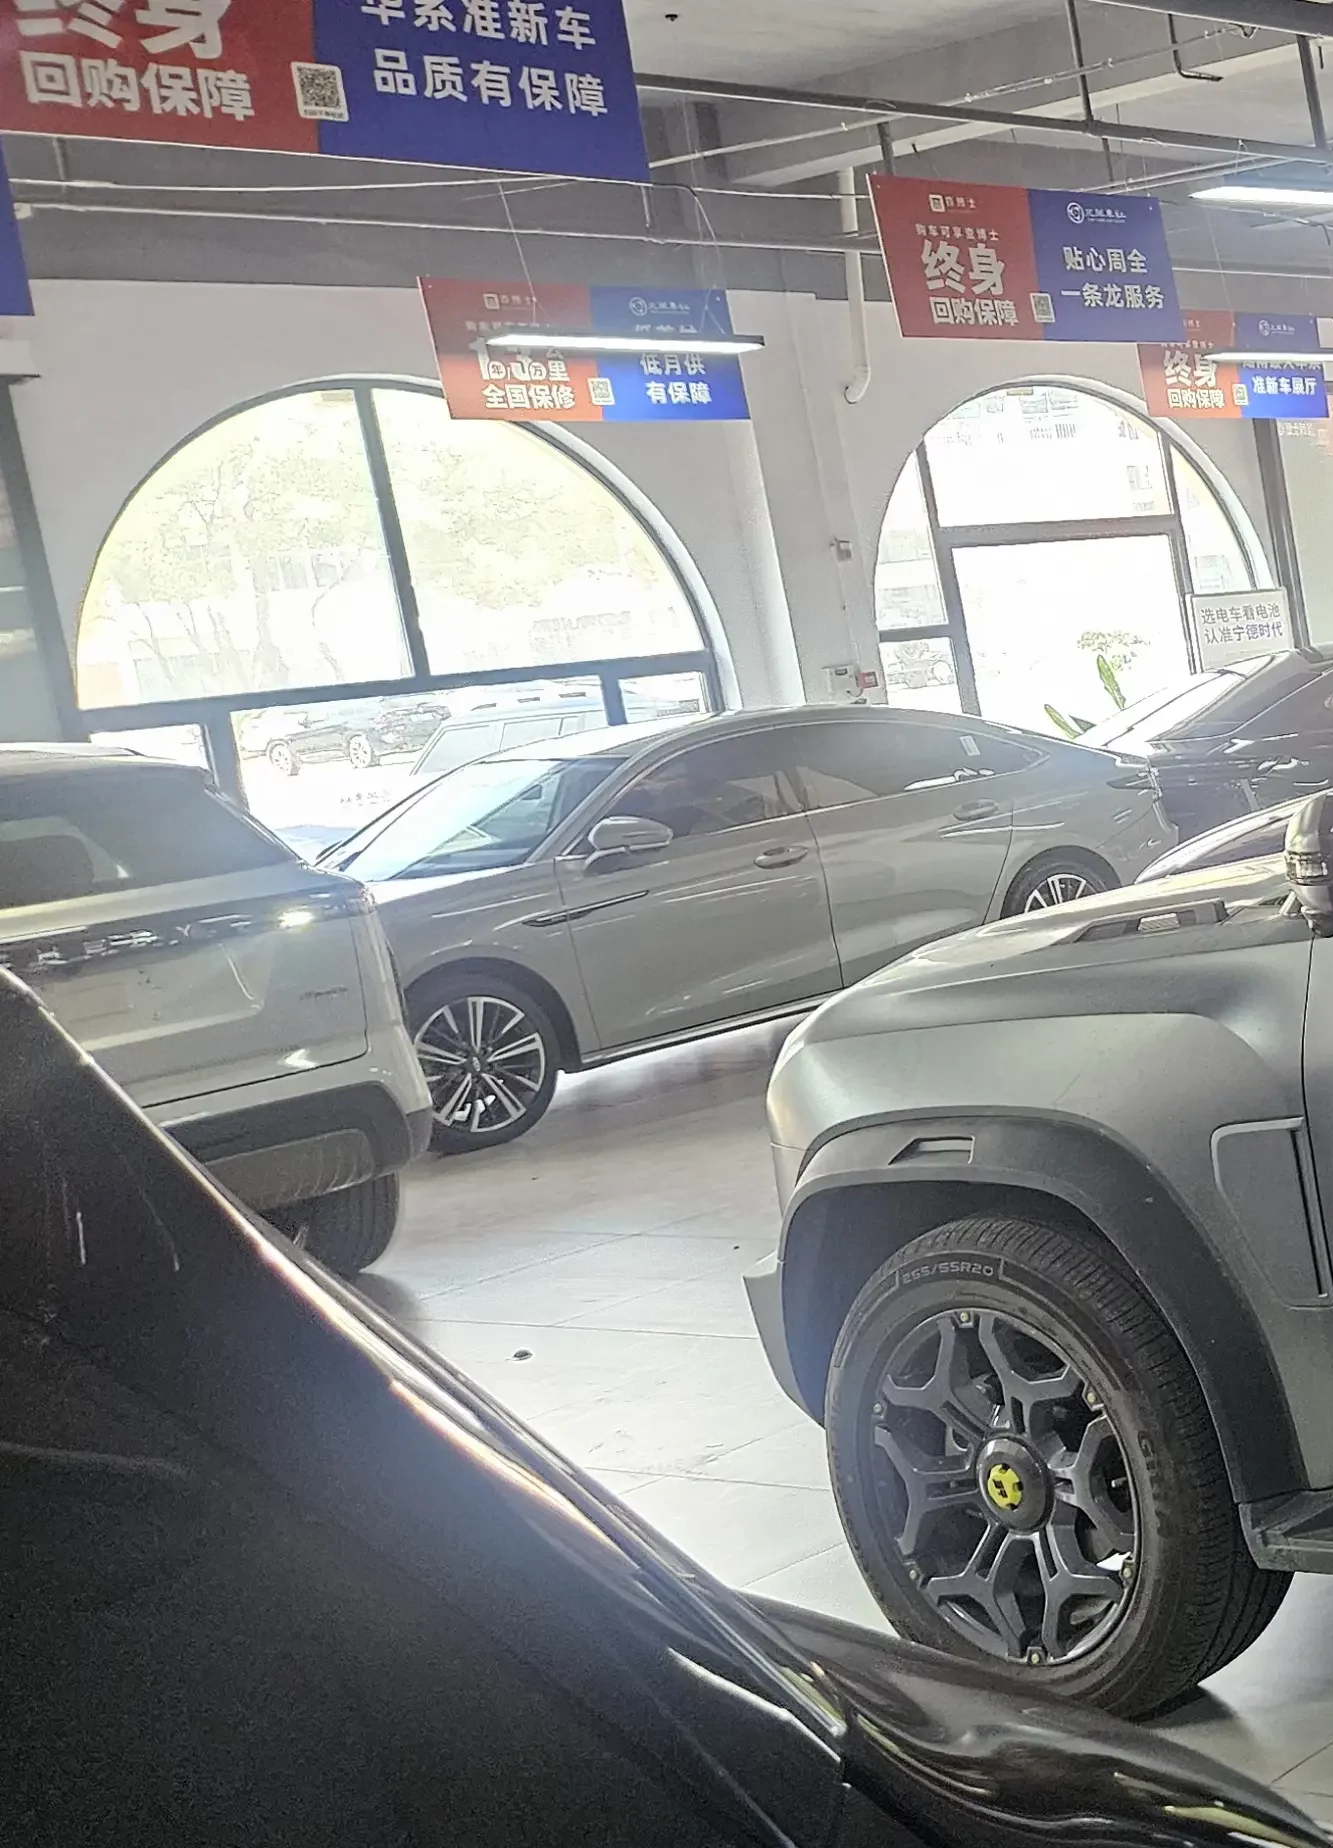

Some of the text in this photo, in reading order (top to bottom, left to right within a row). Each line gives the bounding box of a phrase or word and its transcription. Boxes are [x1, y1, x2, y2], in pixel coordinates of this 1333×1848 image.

[20, 50, 255, 121] 回购保障
[373, 48, 608, 117] 品质有保障
[920, 239, 1005, 296] 终身
[1062, 246, 1148, 274] 贴心周全
[1061, 283, 1165, 310] 一条龙服务
[929, 297, 1019, 326] 回购保障
[640, 352, 707, 377] 低月供
[1163, 350, 1218, 388] 终身
[482, 384, 576, 410] 全国保修
[646, 381, 712, 405] 有保障
[1252, 376, 1317, 395] 准新车展厅
[1167, 389, 1225, 410] 回购保障
[1201, 603, 1281, 624] 选电车看电池
[1204, 622, 1283, 644] 认准宁德时代
